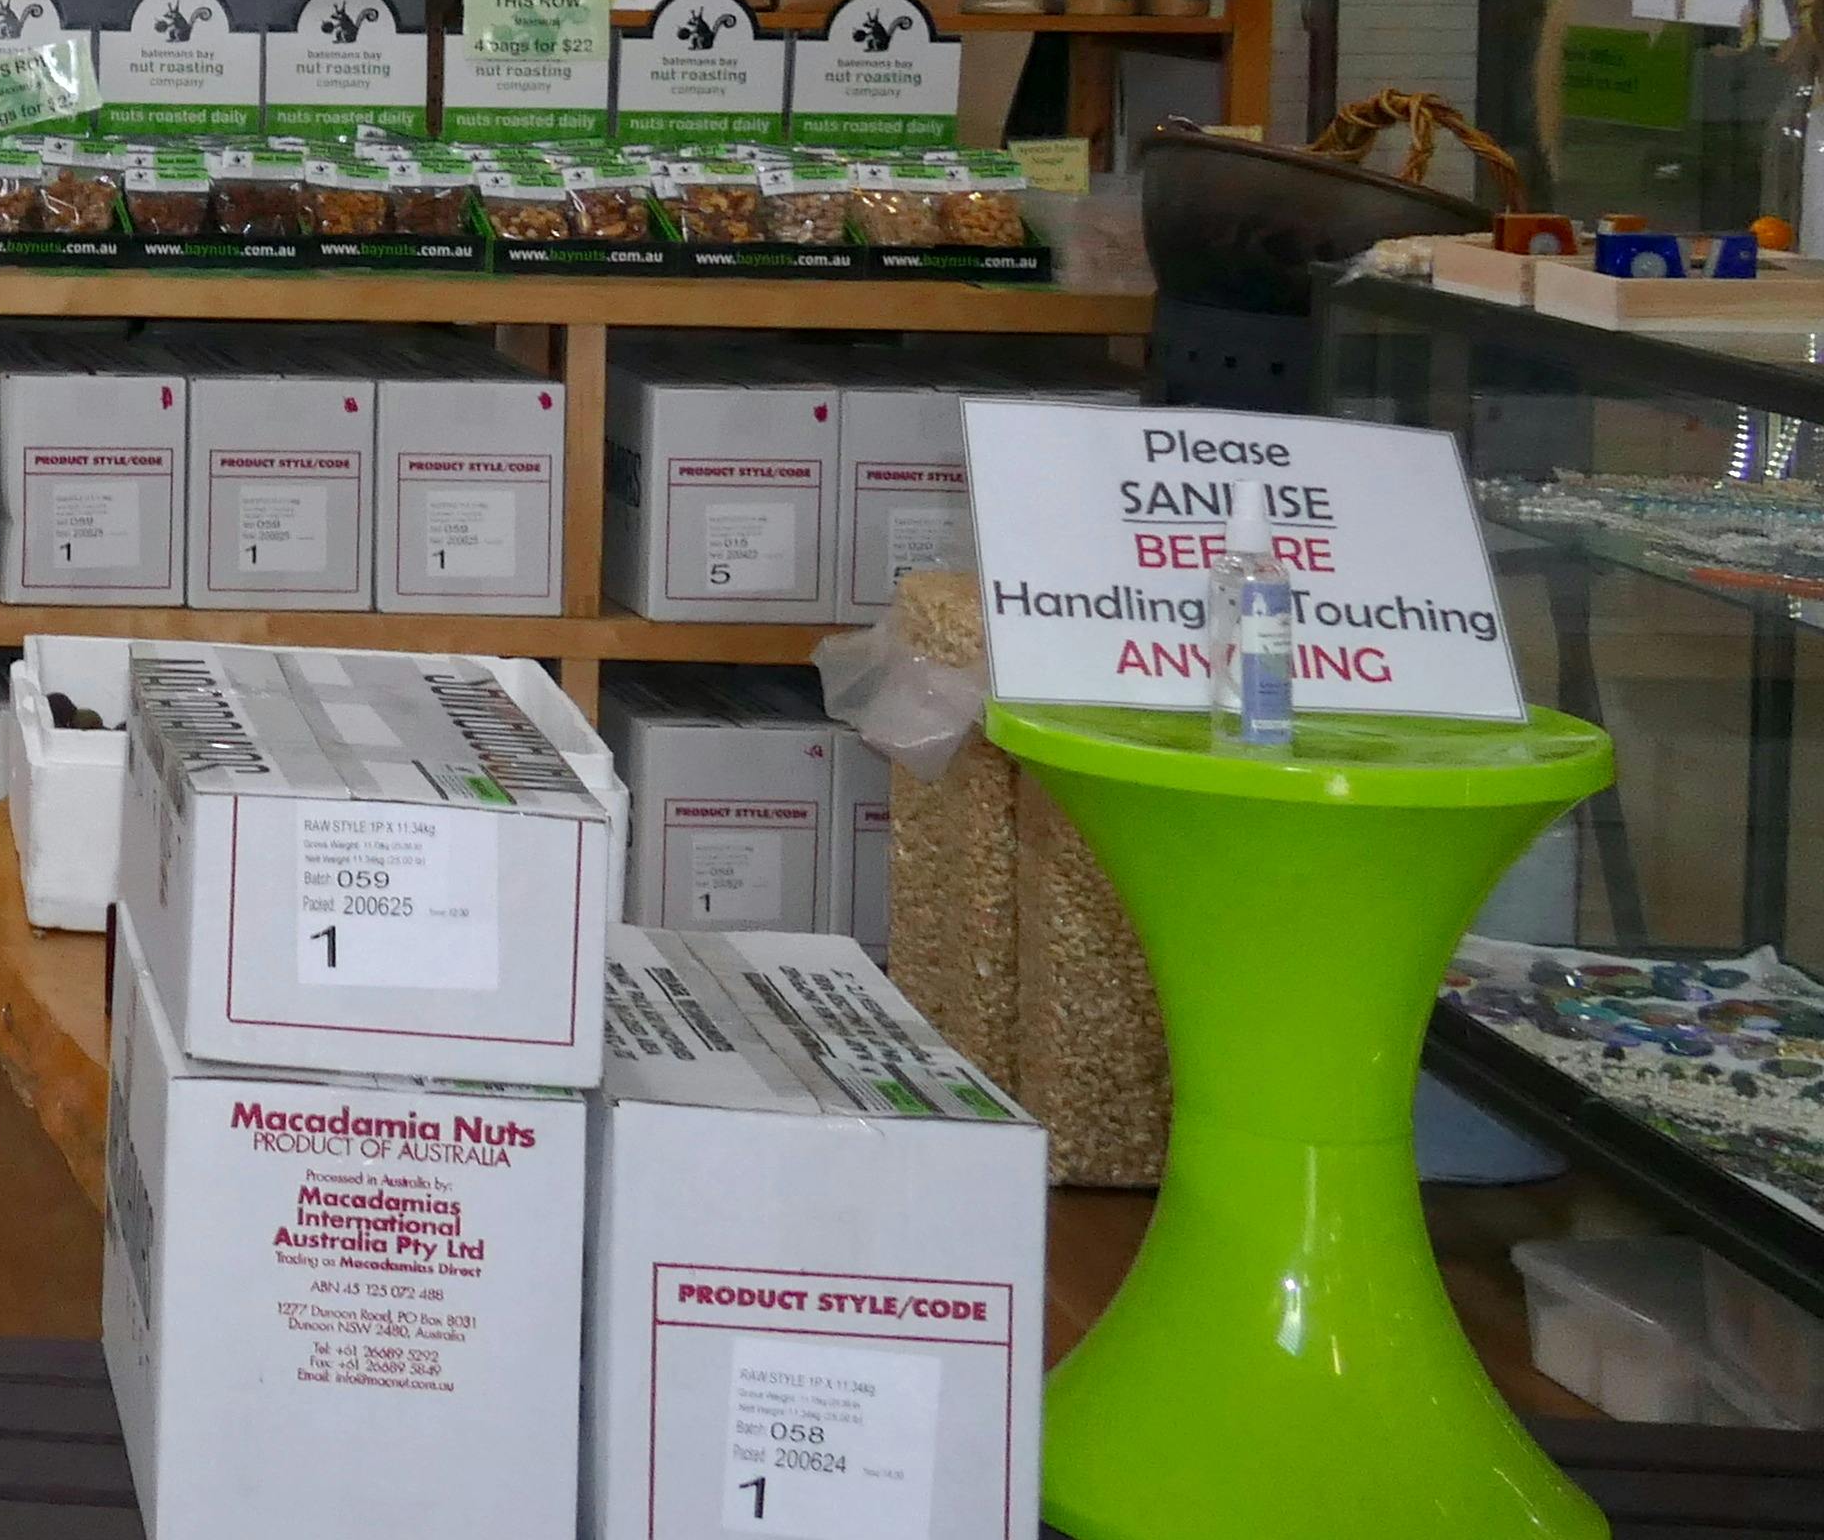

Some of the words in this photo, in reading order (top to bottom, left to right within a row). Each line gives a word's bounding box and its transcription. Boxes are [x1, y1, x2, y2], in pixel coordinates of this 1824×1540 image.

[474, 40, 484, 51] 4
[534, 39, 557, 51] for
[562, 38, 593, 54] $22
[129, 62, 154, 73] nut
[159, 62, 224, 76] roasting
[149, 77, 203, 88] company
[1142, 429, 1292, 467] Please
[1120, 480, 1335, 520] SANIISE
[1135, 532, 1336, 572] BEFRE
[993, 580, 1207, 629] Handling
[1291, 590, 1498, 642] Touching
[1116, 639, 1393, 683] ANYING
[304, 819, 330, 833] RAW
[333, 820, 367, 833] STYLE
[337, 869, 390, 889] 059
[342, 895, 414, 917] 200625
[310, 925, 337, 968] 1
[230, 1101, 441, 1142] Macadamia
[453, 1115, 536, 1149] Nuts
[253, 1130, 352, 1157] PRODUCT
[360, 1138, 392, 1160] OF
[397, 1140, 511, 1168] AUSTRALIA
[306, 1169, 363, 1185] Processed
[367, 1174, 377, 1186] in
[380, 1173, 431, 1190] Australia
[298, 1185, 461, 1216] Macadamias
[297, 1207, 461, 1237] International
[273, 1227, 388, 1253] Australia
[396, 1236, 438, 1261] Pty
[447, 1239, 485, 1261] Ltd
[275, 1251, 319, 1268] Trading
[339, 1257, 434, 1275] Macadamias
[438, 1262, 482, 1278] Direct
[310, 1280, 340, 1295] ABN
[343, 1283, 360, 1296] 45
[366, 1284, 388, 1297] 125
[678, 1283, 809, 1311] PRODUCT
[817, 1292, 988, 1322] STYLE/CODE
[337, 1321, 371, 1335] NSW
[415, 1328, 465, 1342] Australia
[398, 1310, 417, 1325] PO
[770, 1421, 826, 1445] 058
[774, 1447, 847, 1474] 200624
[739, 1476, 767, 1519] 1
